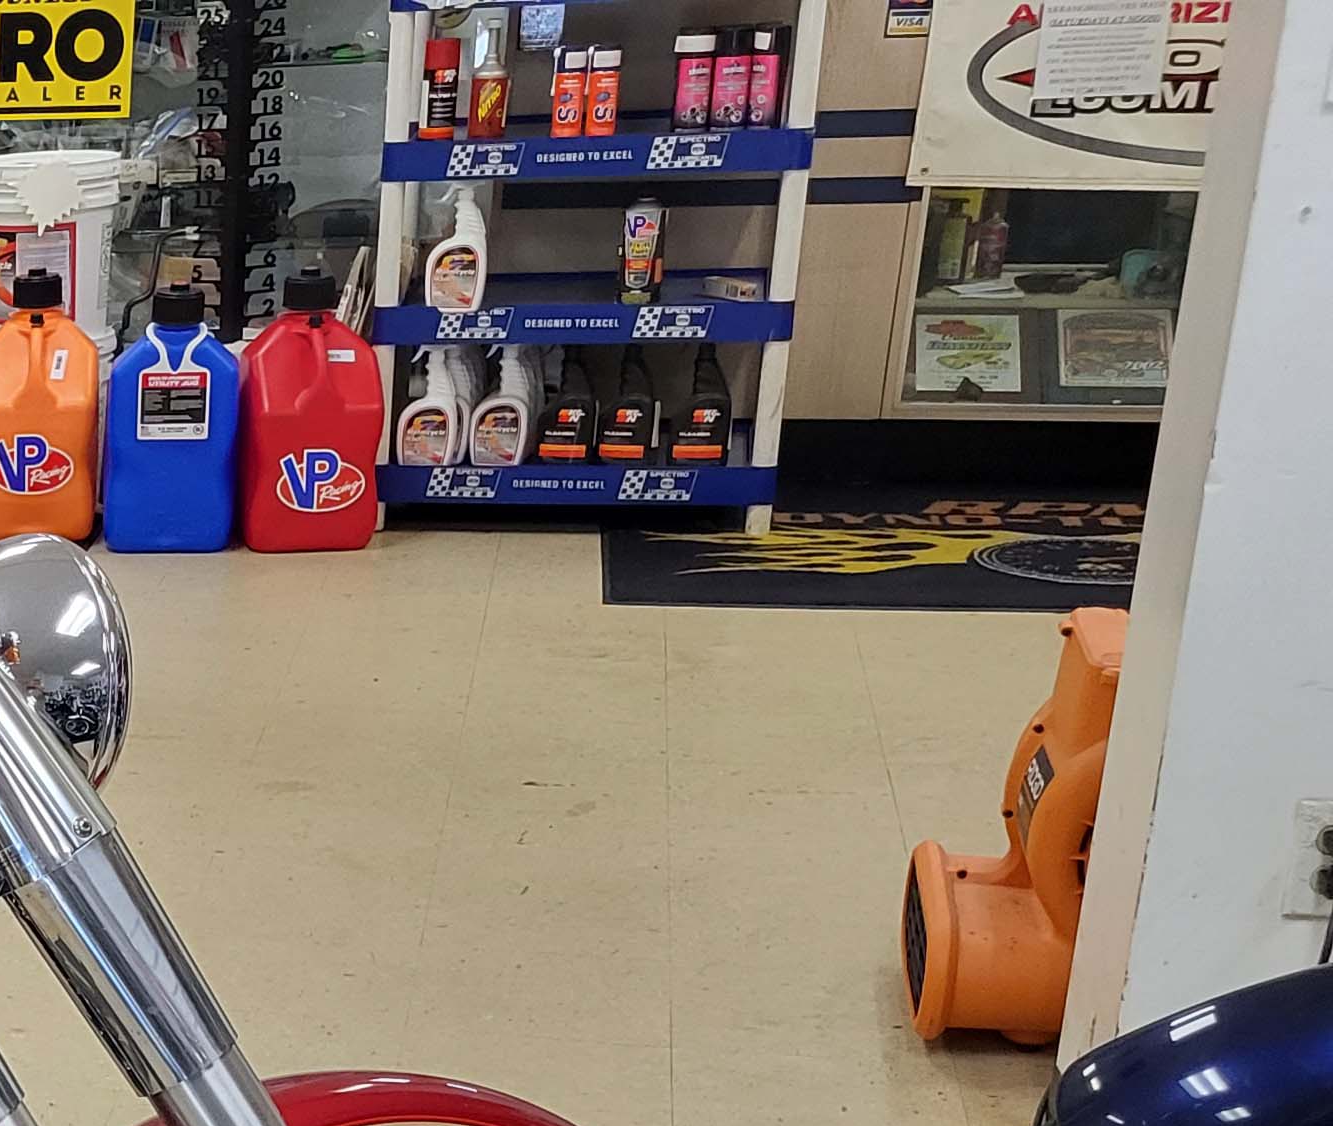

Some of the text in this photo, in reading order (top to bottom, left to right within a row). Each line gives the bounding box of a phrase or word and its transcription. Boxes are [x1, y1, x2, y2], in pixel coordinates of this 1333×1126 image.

[199, 9, 225, 26] 25
[259, 17, 285, 34] 24
[896, 17, 924, 26] VISA
[258, 70, 284, 89] 20
[197, 88, 219, 106] 19
[261, 96, 283, 114] 18
[478, 84, 502, 123] NITRO
[197, 112, 219, 131] 17
[259, 121, 282, 140] 16
[677, 135, 721, 143] SPECTRO
[257, 147, 281, 166] 14
[536, 150, 634, 163] DESIGNED TO EXCEL
[197, 164, 217, 181] 13
[627, 215, 646, 238] VP
[263, 248, 277, 265] 6
[191, 264, 203, 280] 5
[261, 274, 276, 291] 4
[261, 298, 276, 315] 2
[524, 317, 619, 329] DESIGNED TO EXCEL
[29, 464, 73, 487] Racing
[282, 451, 364, 509] VP Racing
[455, 468, 494, 476] SPECTRO
[649, 470, 690, 478] SPECTRO
[512, 479, 605, 490] DESIGNED TO EXCEL
